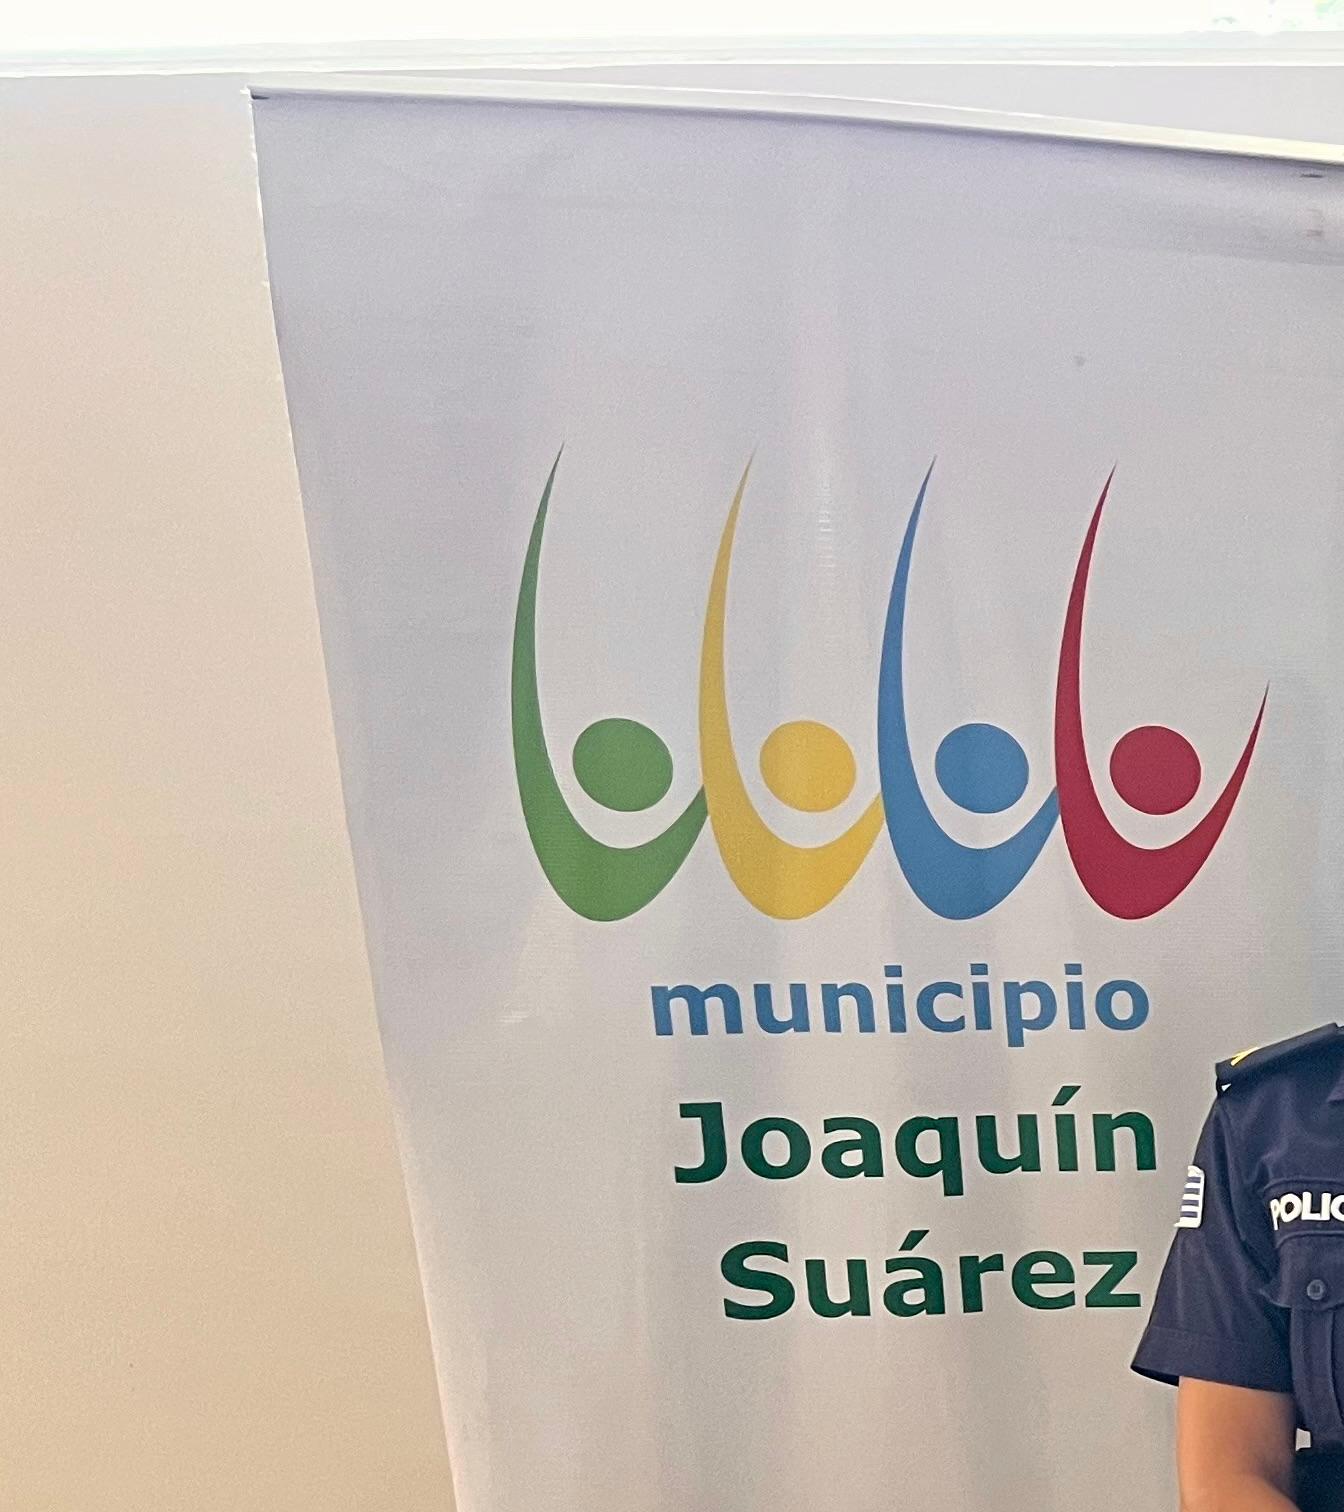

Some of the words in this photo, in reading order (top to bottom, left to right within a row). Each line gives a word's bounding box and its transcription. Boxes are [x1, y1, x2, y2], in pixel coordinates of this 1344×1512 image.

[651, 964, 1151, 1047] municipio
[674, 1087, 1157, 1198] Joaquín
[721, 1230, 1142, 1321] Suárez
